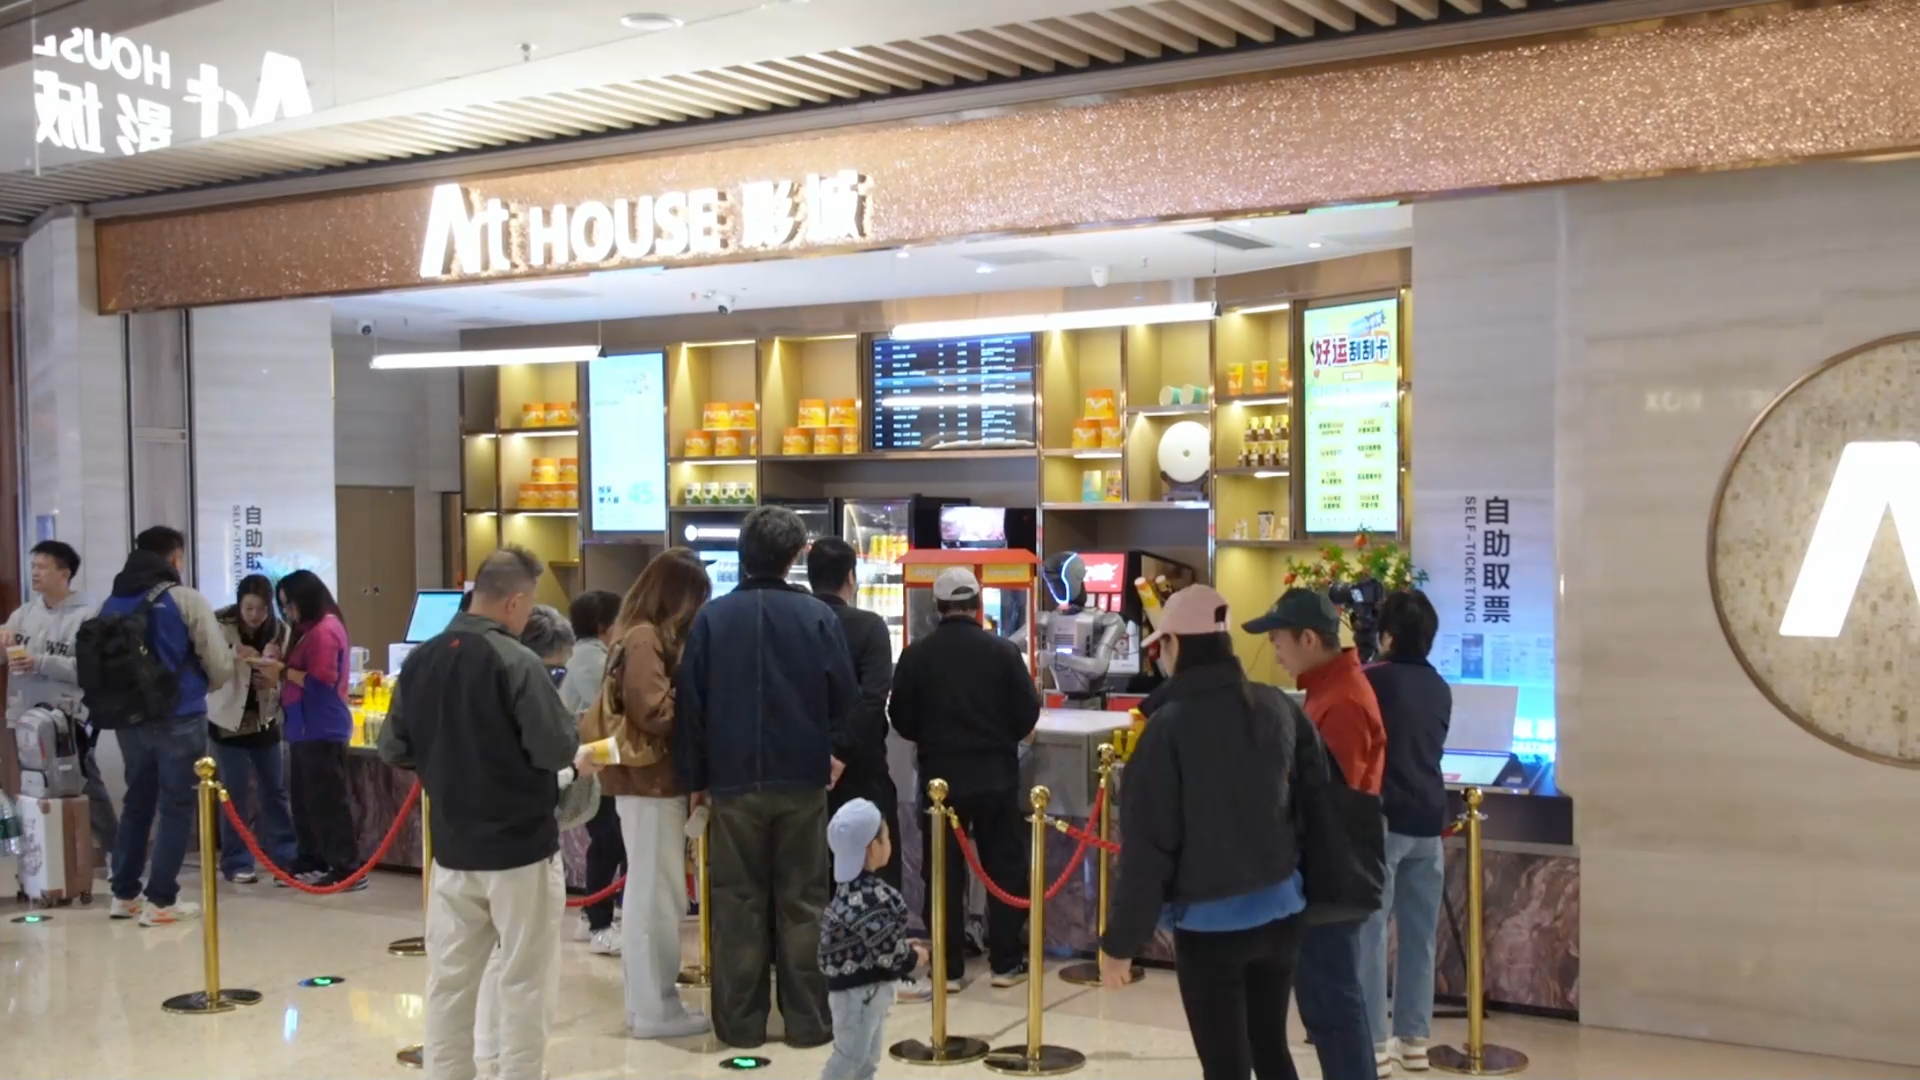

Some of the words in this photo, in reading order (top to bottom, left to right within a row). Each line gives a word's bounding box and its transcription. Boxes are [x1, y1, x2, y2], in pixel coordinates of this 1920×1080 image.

[420, 183, 511, 278] Art
[529, 188, 723, 265] HOUSE
[742, 169, 860, 247] 影城
[1314, 337, 1389, 366] 好运刮刮卡
[1464, 496, 1477, 623] SELF-TICKETING
[1482, 496, 1511, 623] 自助取票
